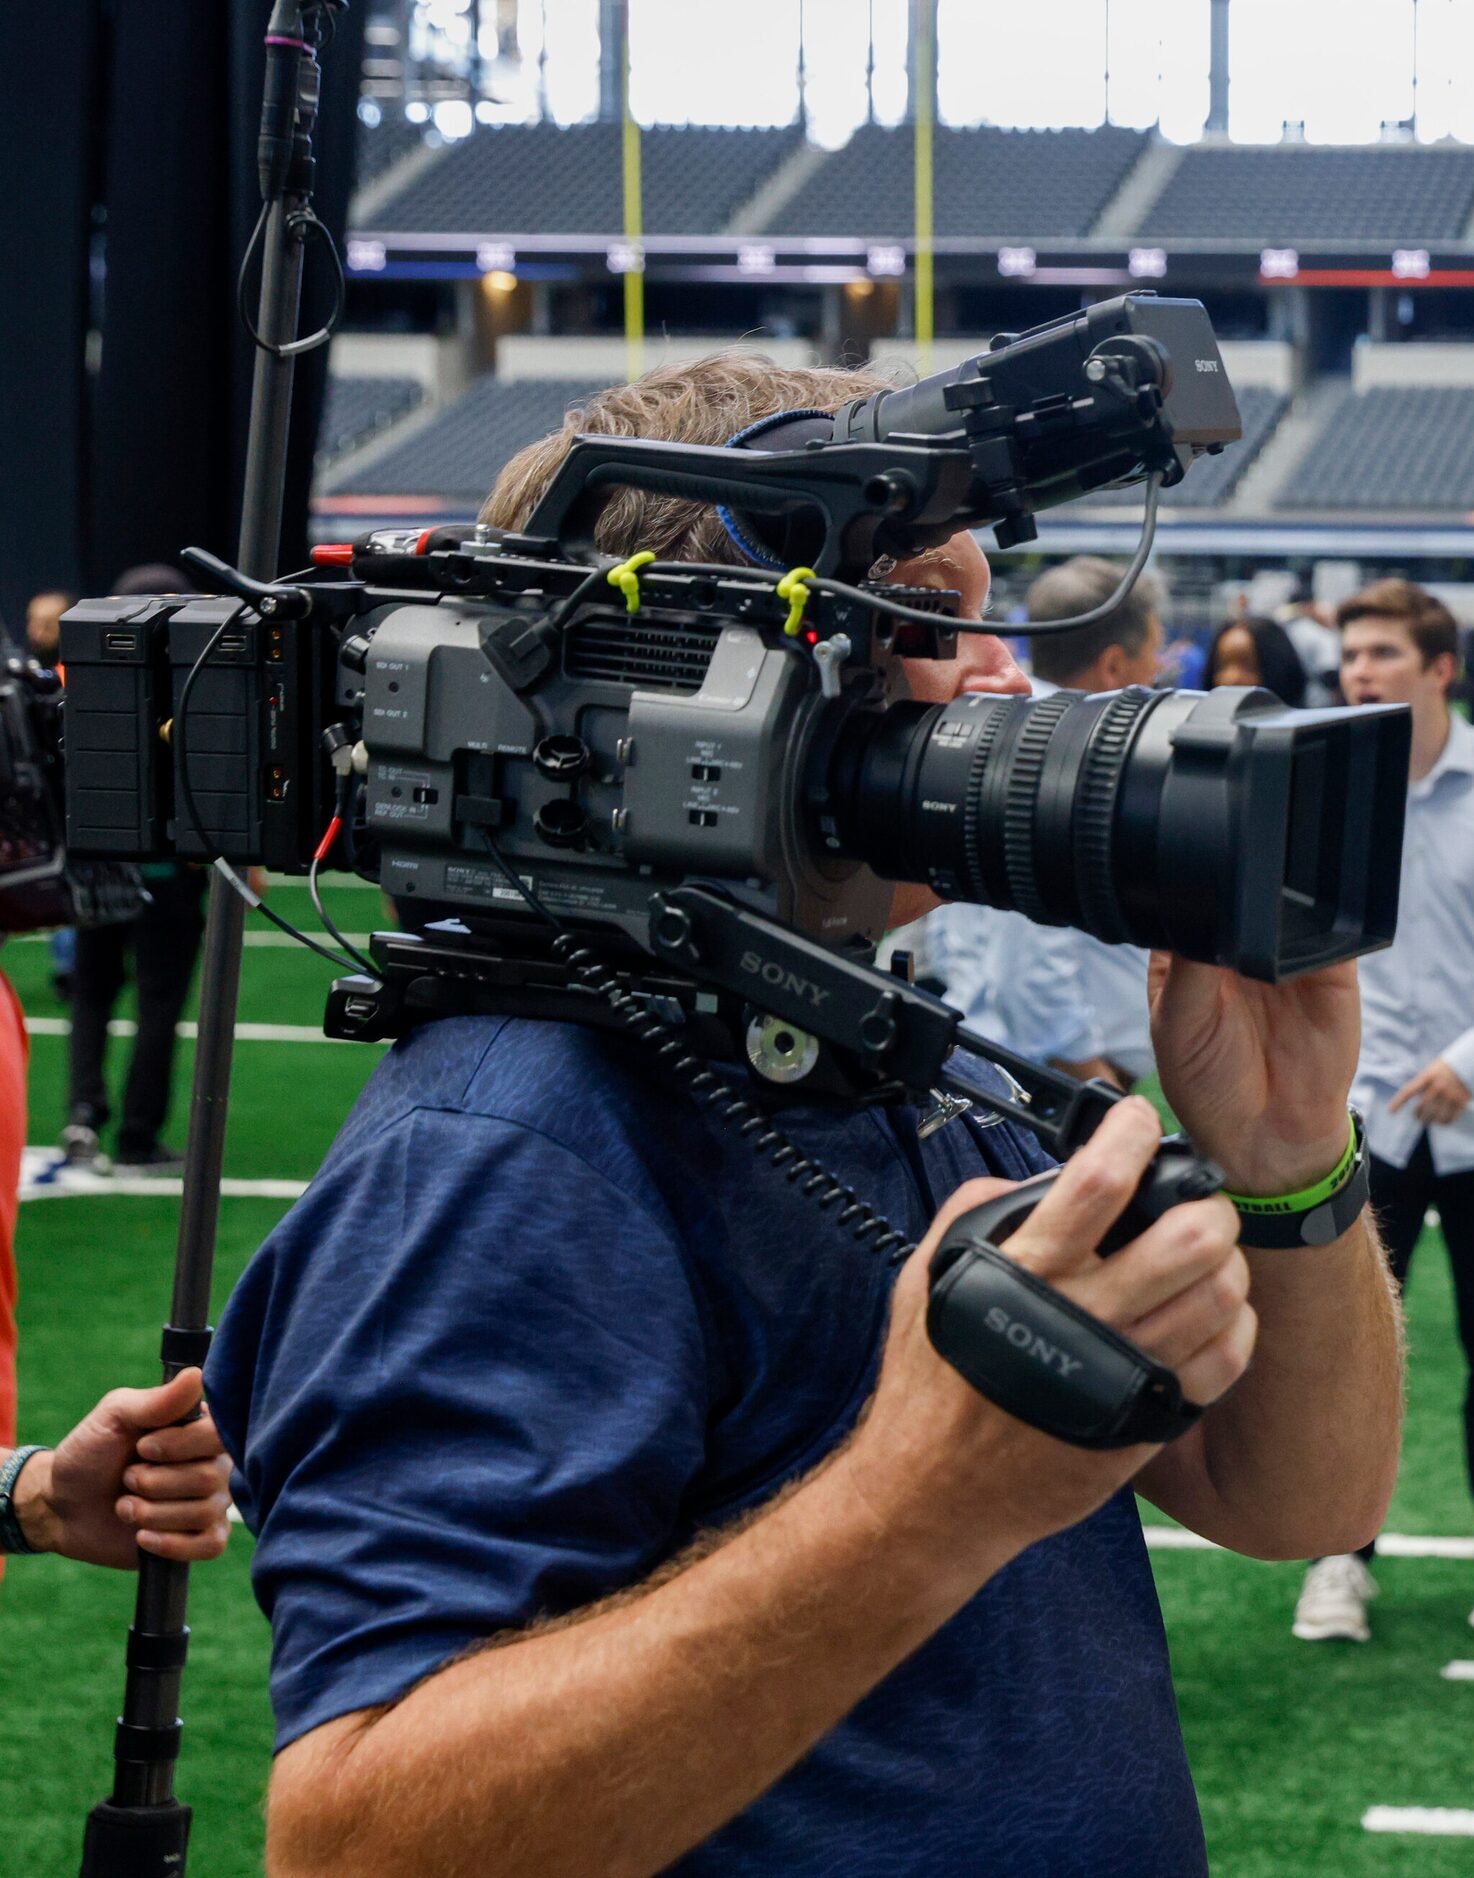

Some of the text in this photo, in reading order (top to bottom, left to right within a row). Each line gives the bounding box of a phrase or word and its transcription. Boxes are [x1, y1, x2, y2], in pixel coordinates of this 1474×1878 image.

[1194, 359, 1219, 373] SONY
[389, 662, 403, 671] OUT
[921, 800, 958, 814] SONY
[391, 859, 419, 870] HDMI
[739, 950, 831, 1008] SONY
[983, 1306, 1083, 1378] SONY
